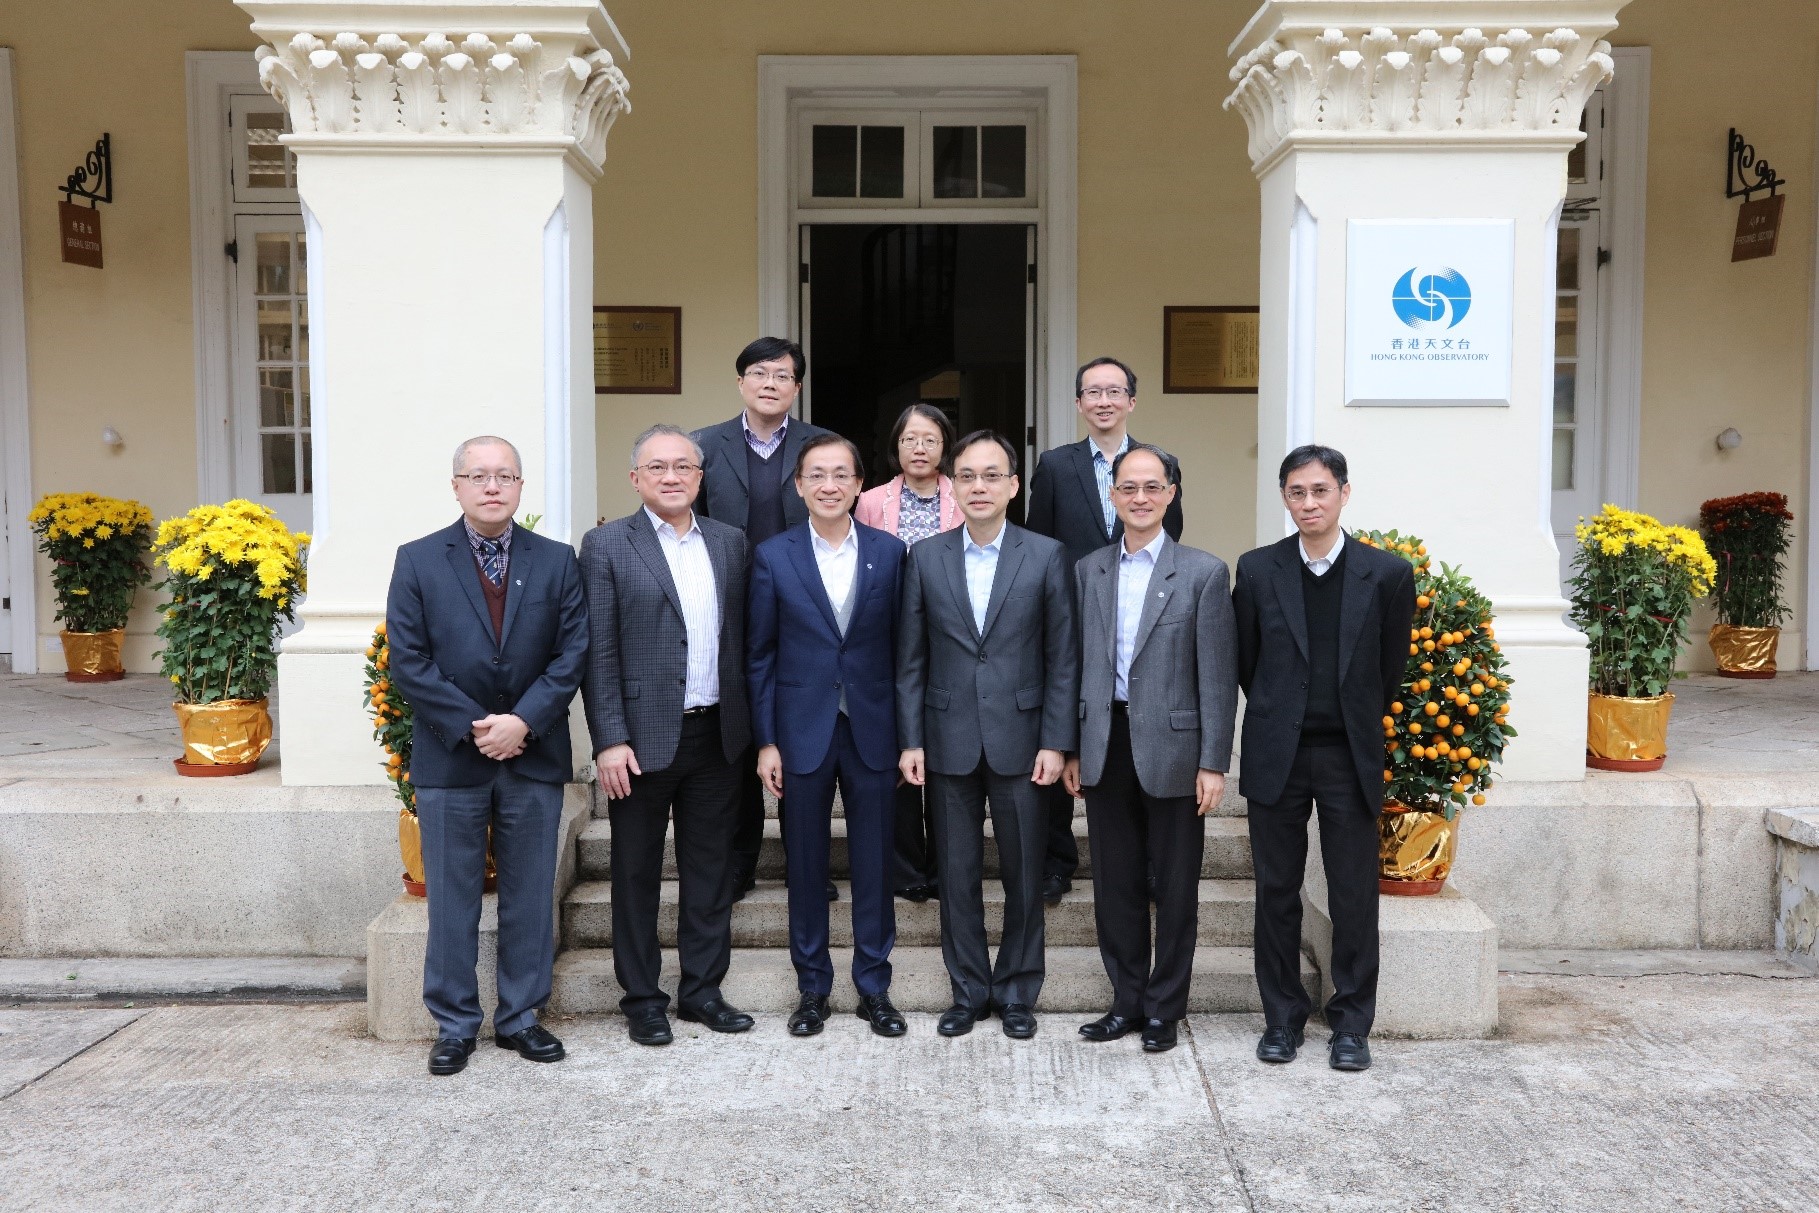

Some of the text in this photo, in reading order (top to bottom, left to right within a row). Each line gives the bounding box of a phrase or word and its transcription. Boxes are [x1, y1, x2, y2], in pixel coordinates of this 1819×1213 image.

[66, 237, 100, 252] GENERAL SECTION
[1391, 338, 1471, 350] 香港天文台
[1371, 353, 1490, 361] HONG KONG OBSERVATORY
